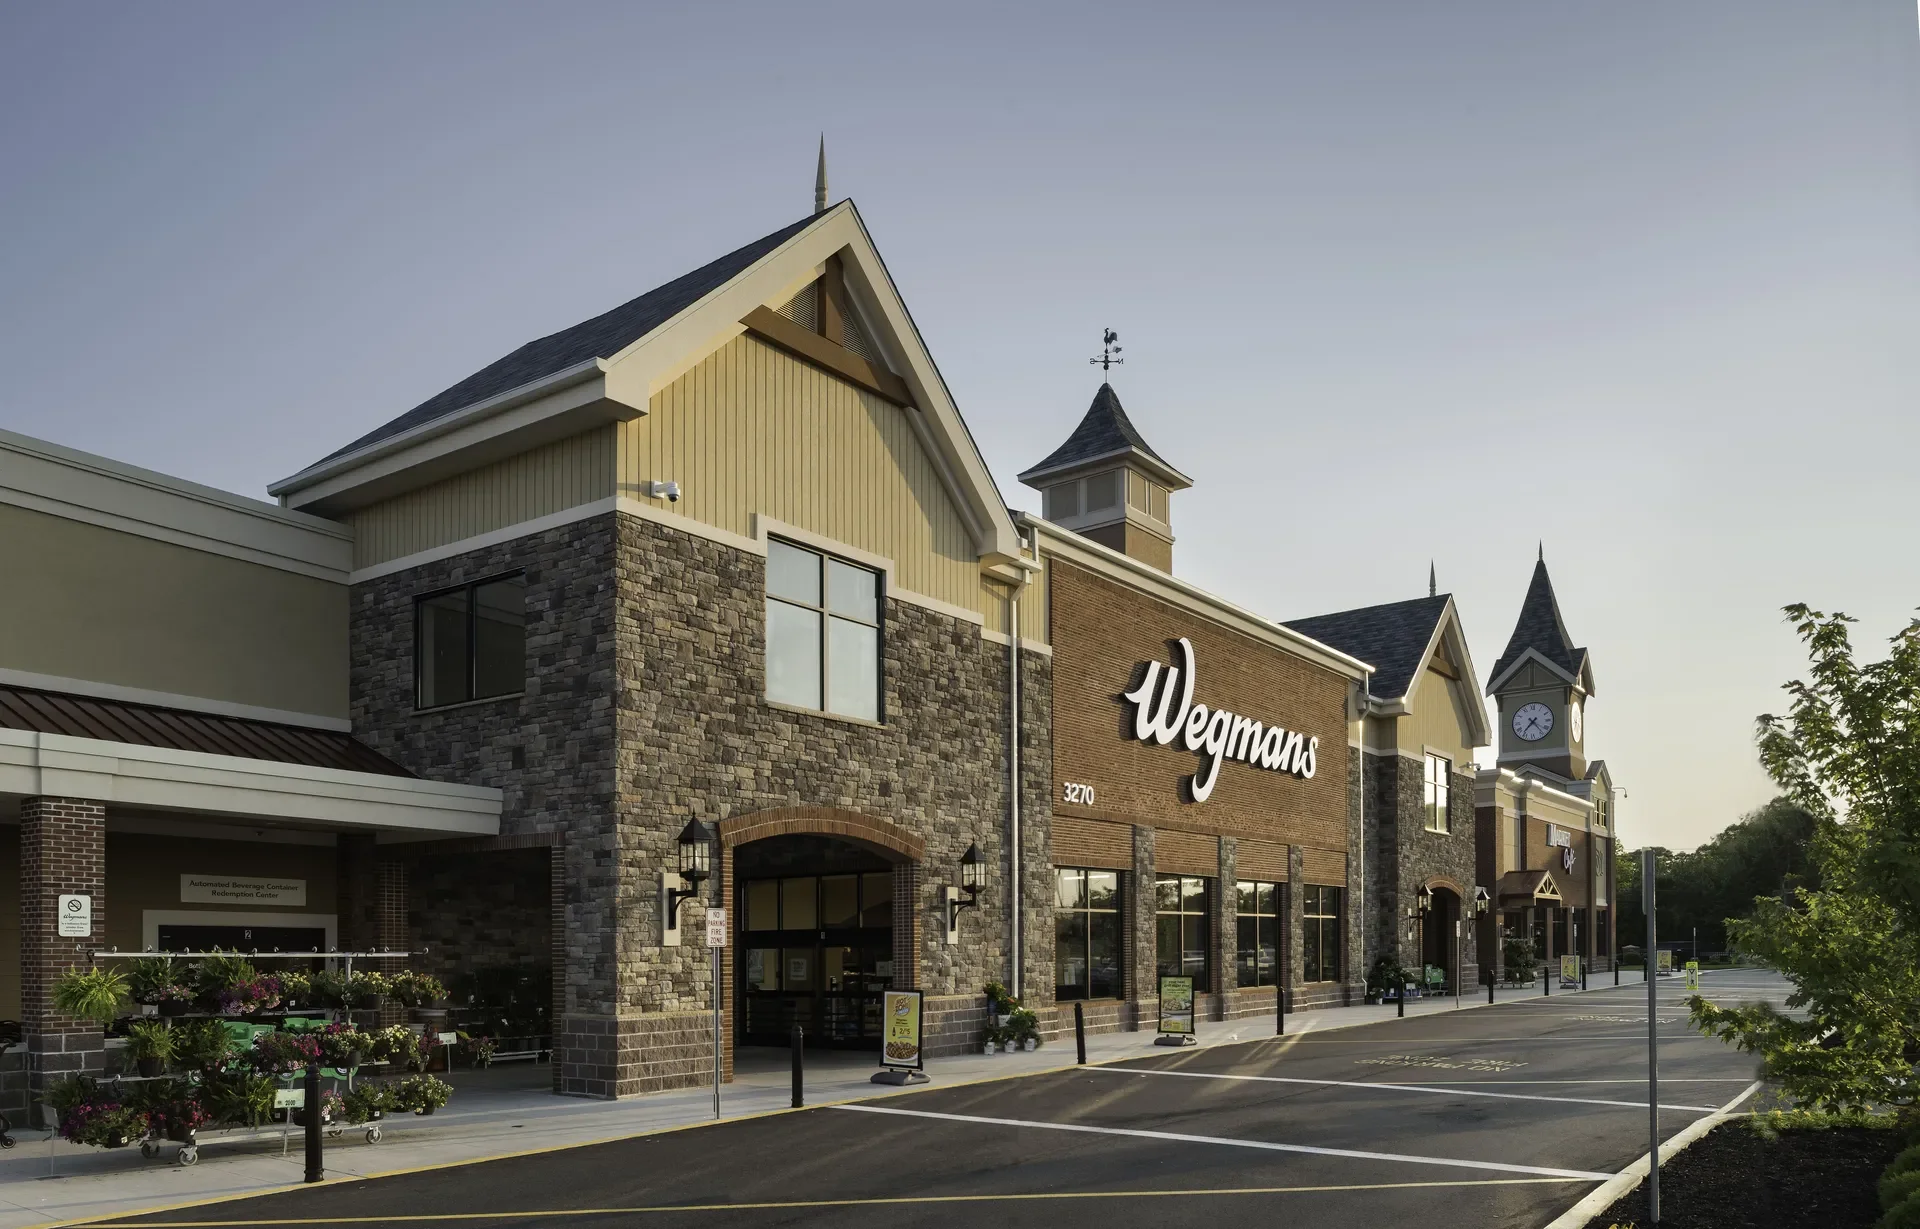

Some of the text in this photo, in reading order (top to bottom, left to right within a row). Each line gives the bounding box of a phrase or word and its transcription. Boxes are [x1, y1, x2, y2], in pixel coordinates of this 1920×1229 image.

[1124, 637, 1318, 803] Wegmans
[1063, 782, 1095, 806] 3270
[189, 880, 299, 891] Automated Beverage Container
[211, 890, 279, 899] Redemption Center
[712, 911, 721, 919] NO
[245, 930, 251, 939] 2
